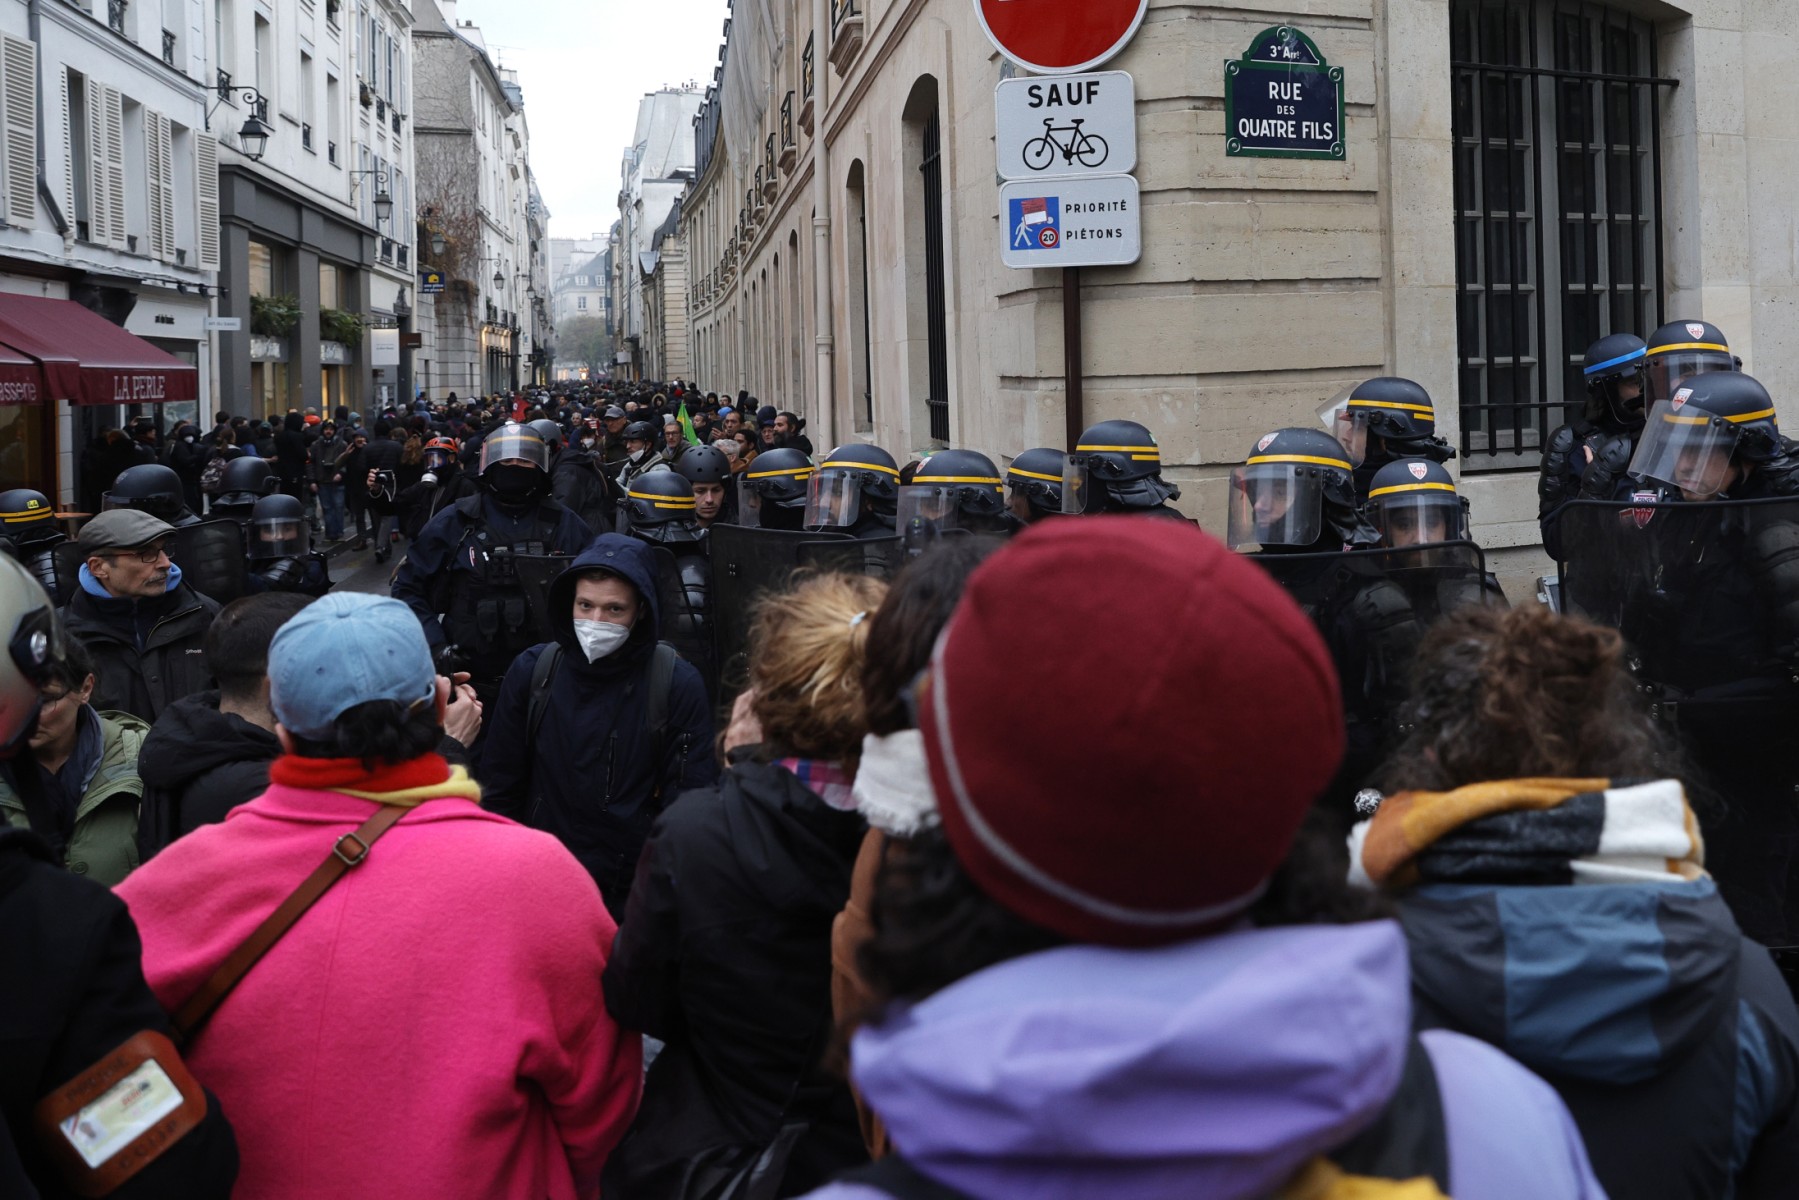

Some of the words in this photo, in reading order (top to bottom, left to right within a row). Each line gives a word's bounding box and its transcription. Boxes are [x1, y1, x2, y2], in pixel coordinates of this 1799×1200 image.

[1027, 80, 1100, 108] SAUF
[1268, 81, 1303, 101] RUE
[1276, 105, 1295, 115] DES
[1238, 118, 1297, 138] QUATRE
[1302, 121, 1333, 140] FILS
[1065, 199, 1127, 214] PRIORITÉ
[1043, 233, 1055, 242] 20
[1066, 228, 1123, 240] PIÉTONS
[114, 375, 130, 400] LA
[132, 375, 166, 399] PERLE
